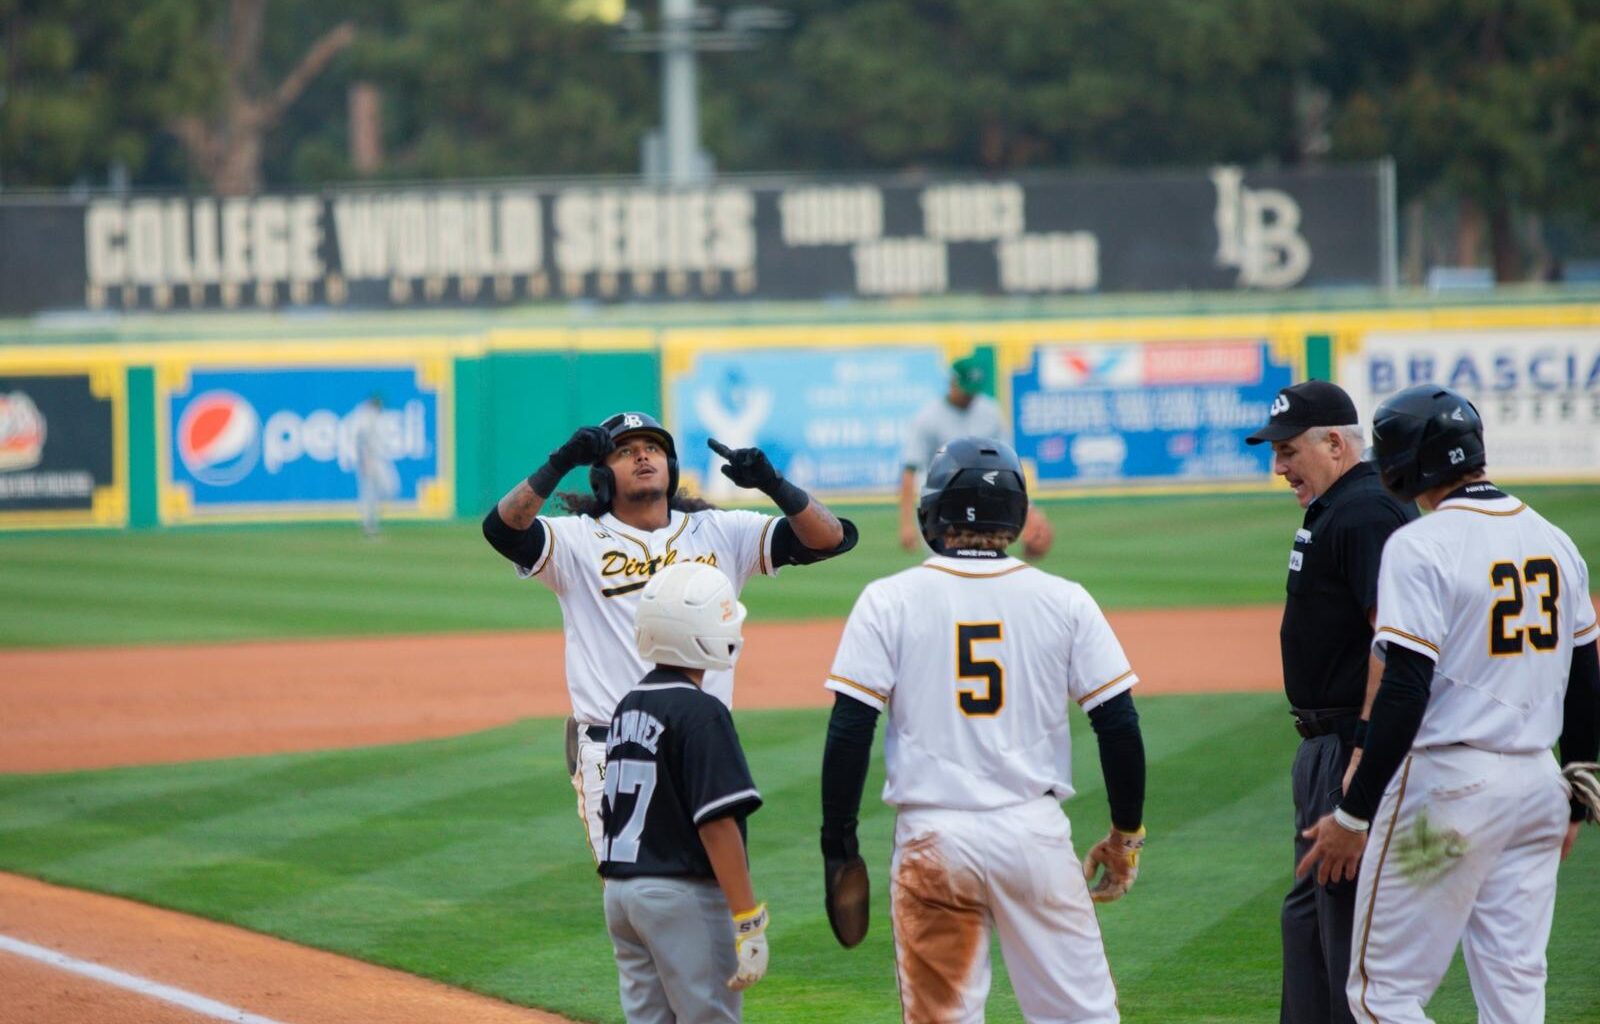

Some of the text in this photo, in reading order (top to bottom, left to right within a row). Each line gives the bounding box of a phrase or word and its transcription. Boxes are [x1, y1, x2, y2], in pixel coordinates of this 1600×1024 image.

[85, 196, 325, 284] COLLEGE
[333, 193, 542, 278] WORLD
[553, 187, 756, 273] SERIES
[1448, 447, 1466, 465] 23
[1489, 557, 1560, 658] 23
[956, 622, 1006, 720] 5
